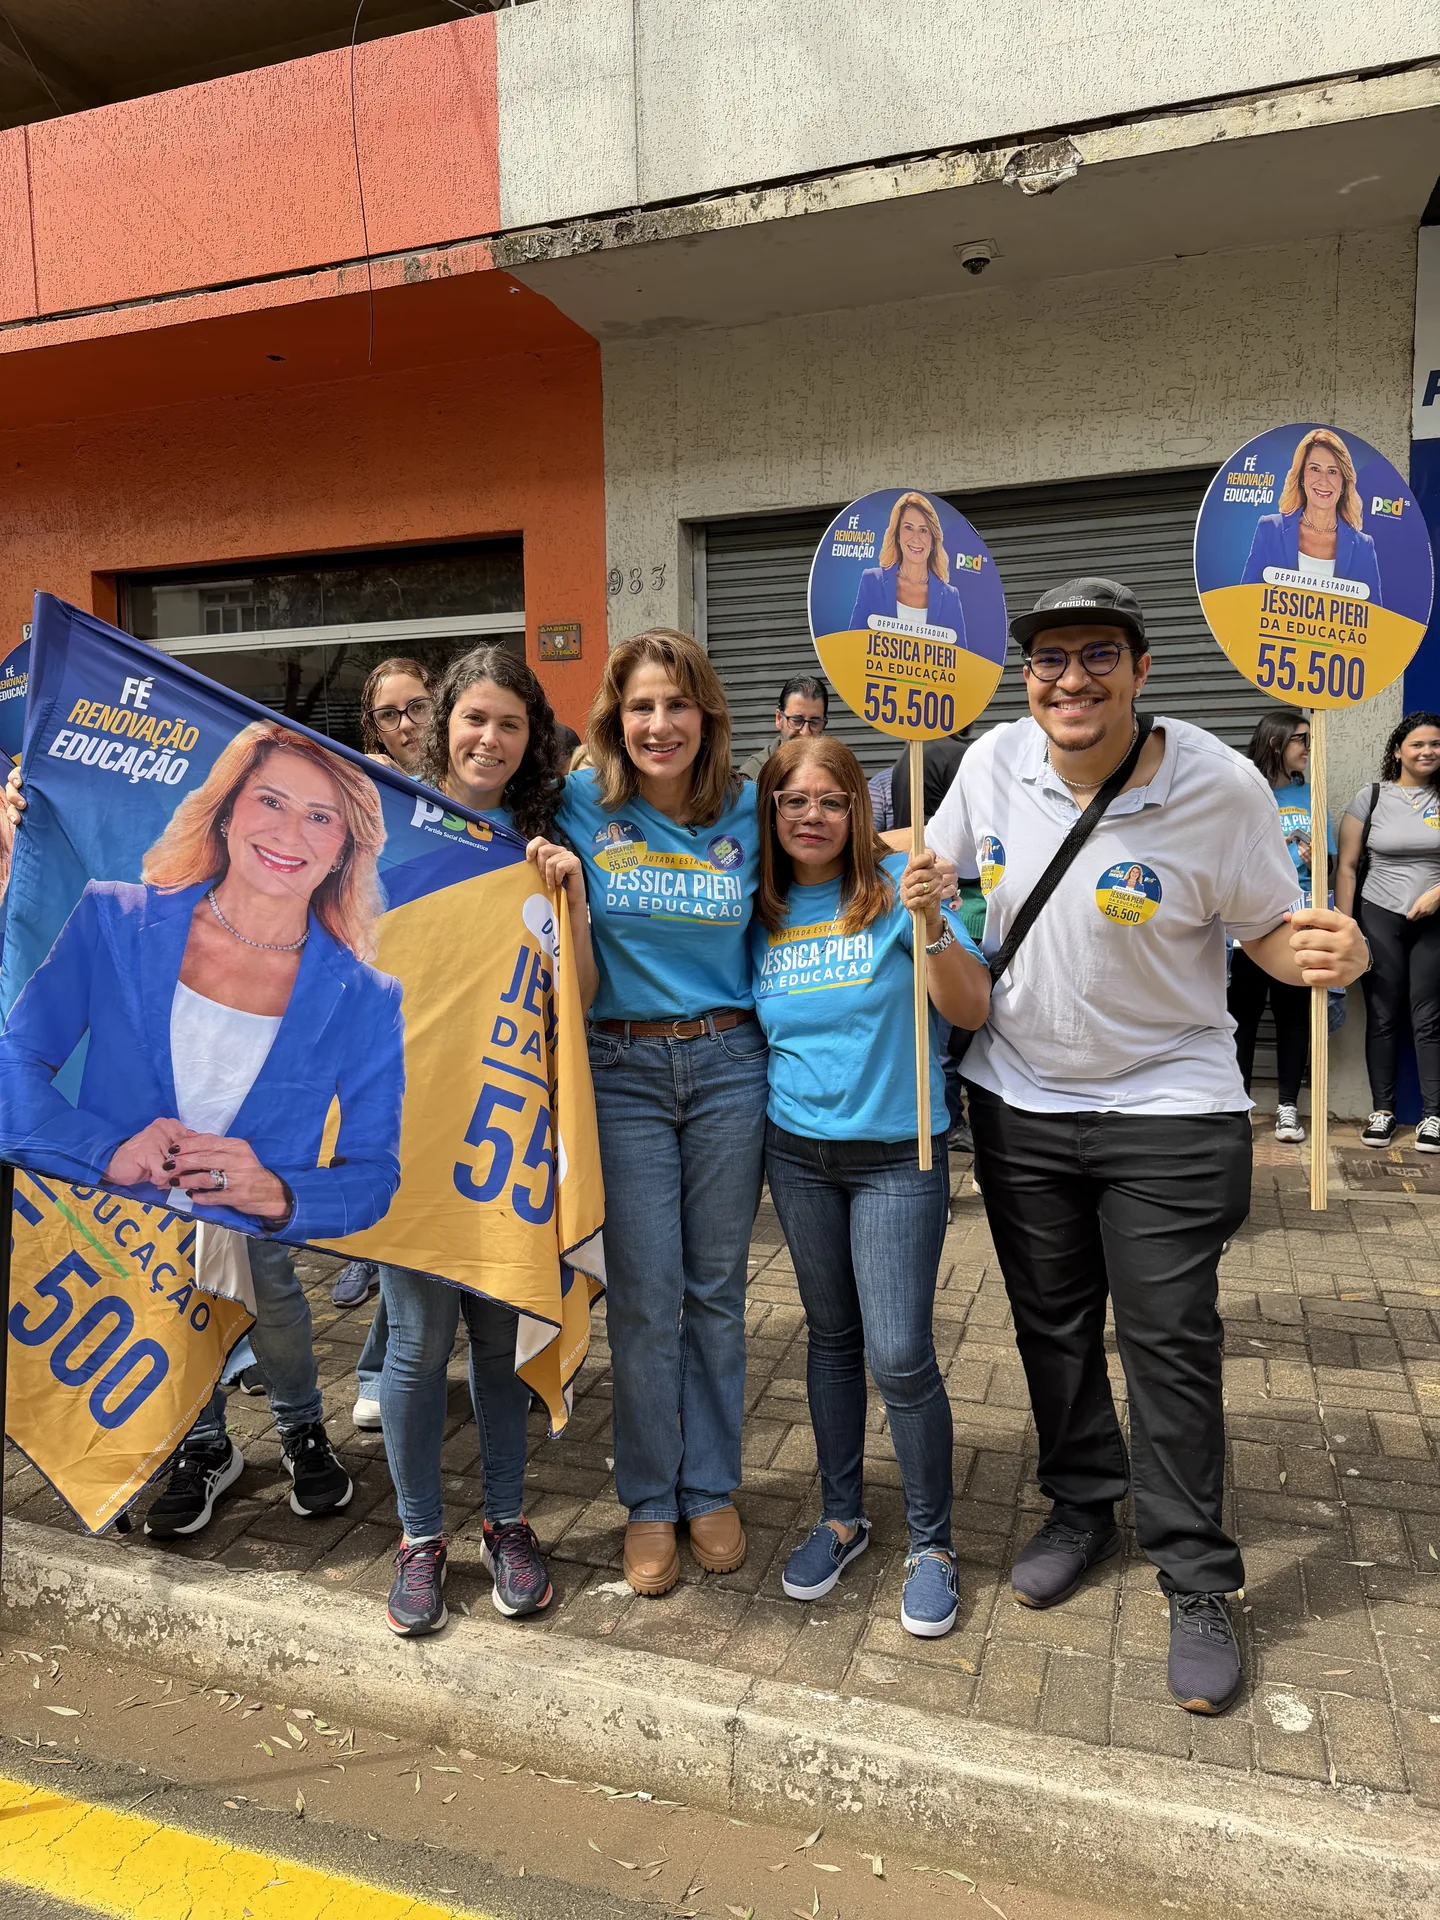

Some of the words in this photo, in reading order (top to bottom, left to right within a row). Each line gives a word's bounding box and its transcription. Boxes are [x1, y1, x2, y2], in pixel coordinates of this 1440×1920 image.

[1243, 454, 1257, 472] FÉ
[1226, 471, 1275, 489] RENOVAÇÃO
[1223, 486, 1274, 507] EDUCAÇÃO
[1371, 496, 1404, 516] psd
[848, 514, 860, 530] FÉ
[833, 529, 875, 545] RENOVAÇÃO
[832, 543, 875, 561] EDUCAÇÃO
[956, 552, 983, 571] psd
[608, 562, 667, 596] 983
[1274, 572, 1318, 587] DEPUTADA
[1320, 581, 1360, 595] ESTADUAL
[1261, 585, 1325, 621] JÉSSICA
[1329, 599, 1369, 629] PIERI
[877, 619, 913, 633] DEPUTADA
[915, 626, 949, 640] ESTADUAL
[1260, 617, 1281, 631] DA
[1286, 620, 1367, 645] EDUCAÇÃO
[866, 631, 920, 663] JÉSSICA
[924, 643, 957, 670] PIERI
[866, 659, 883, 672] DA
[888, 663, 956, 683] EDUCAÇÃO
[1256, 642, 1365, 701] 55.500
[119, 676, 155, 710] FÉ
[864, 682, 955, 732] 55.500
[67, 698, 199, 751] RENOVAÇÃO
[47, 729, 190, 785] EDUCAÇÃO
[608, 855, 639, 871] 55.500
[693, 873, 742, 900] PIERI
[606, 893, 630, 908] DA
[638, 896, 742, 919] EDUCAÇÃO
[1105, 904, 1141, 923] 55.500
[775, 929, 811, 942] DEPUTADA
[760, 941, 820, 977] JÉSSICA
[825, 933, 873, 965] PIERI
[760, 978, 775, 993] DA
[779, 961, 872, 989] EDUCAÇÃO
